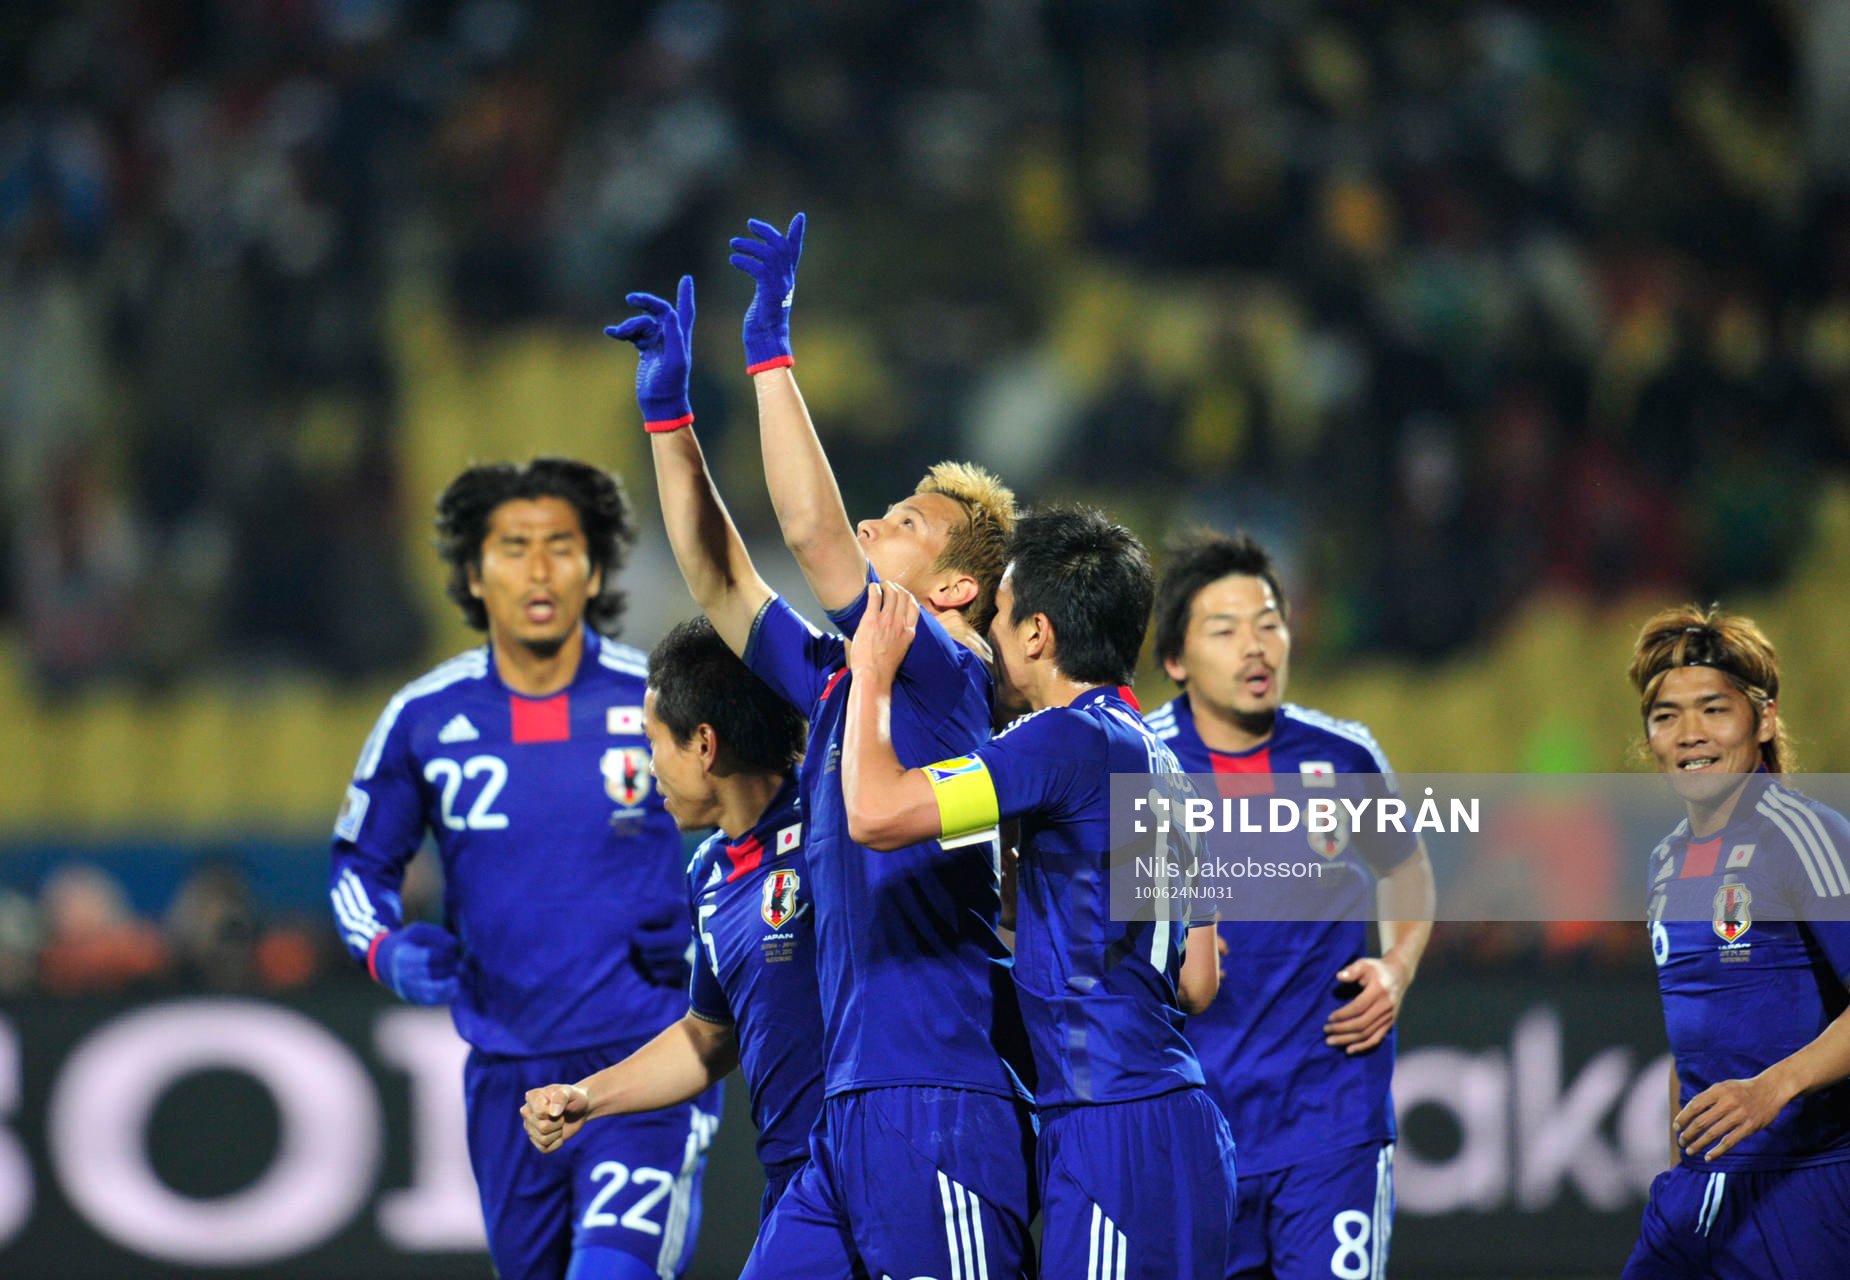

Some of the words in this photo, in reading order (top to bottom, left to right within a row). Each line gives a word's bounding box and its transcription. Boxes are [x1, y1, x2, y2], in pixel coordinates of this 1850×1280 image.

[424, 754, 509, 831] 22
[763, 933, 794, 941] JAPAN
[582, 1160, 673, 1235] 22
[1331, 1209, 1371, 1280] 8
